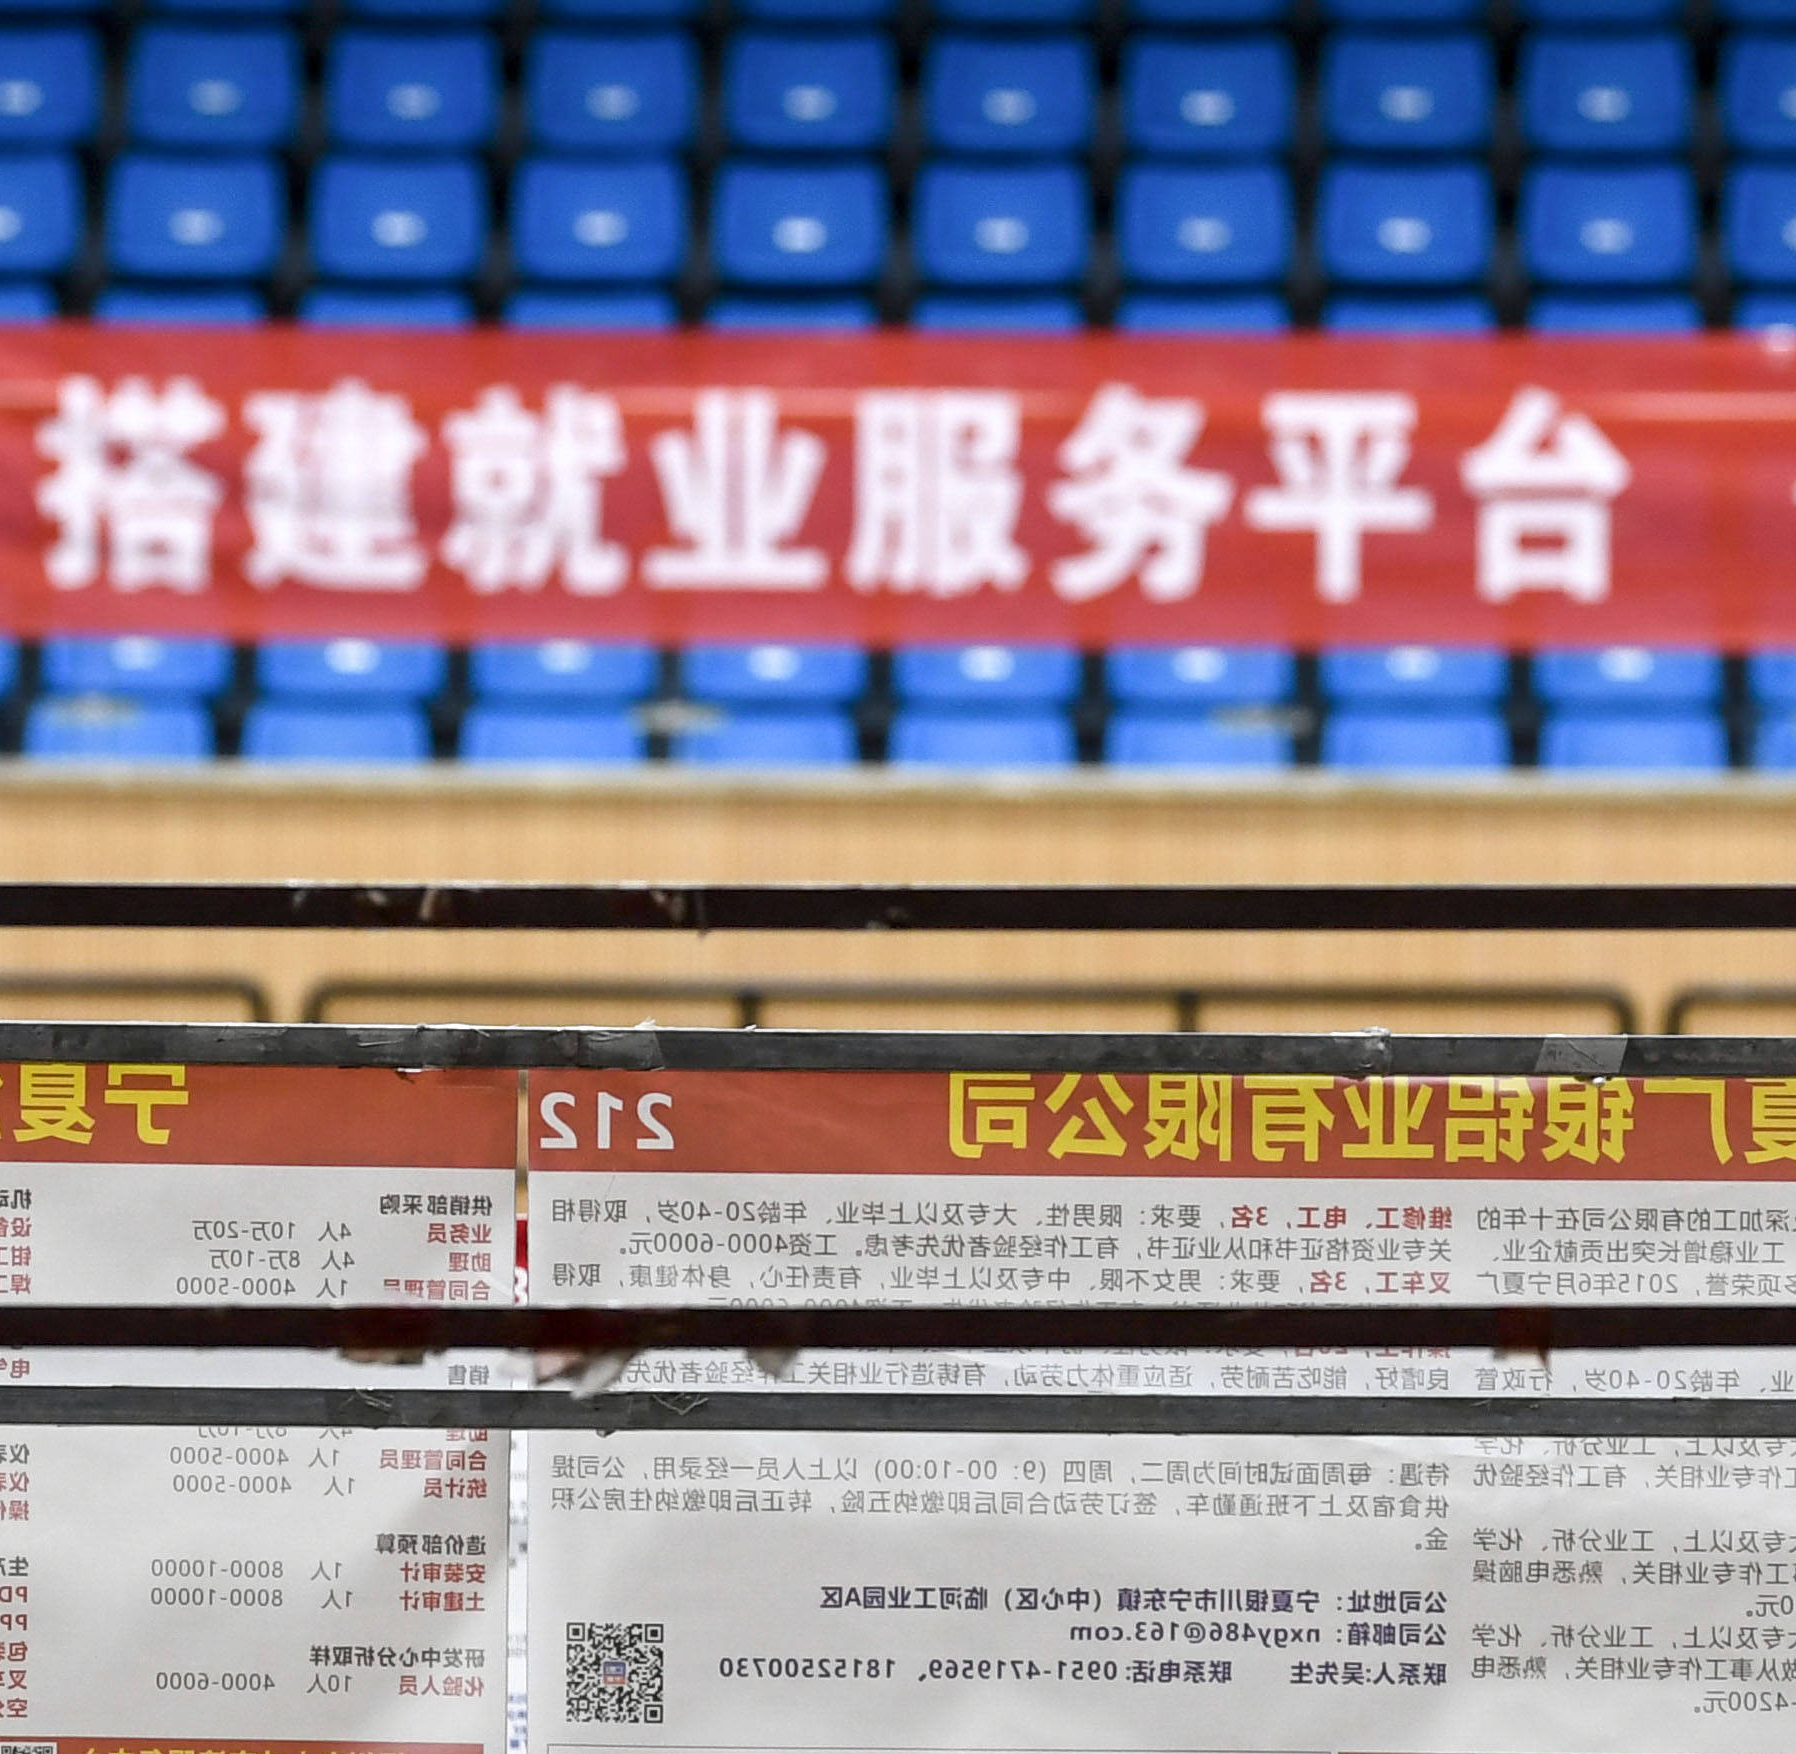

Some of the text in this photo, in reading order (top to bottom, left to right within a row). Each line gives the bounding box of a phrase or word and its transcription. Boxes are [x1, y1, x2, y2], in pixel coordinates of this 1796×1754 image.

[39, 384, 1632, 603] 搭建就业服务平台
